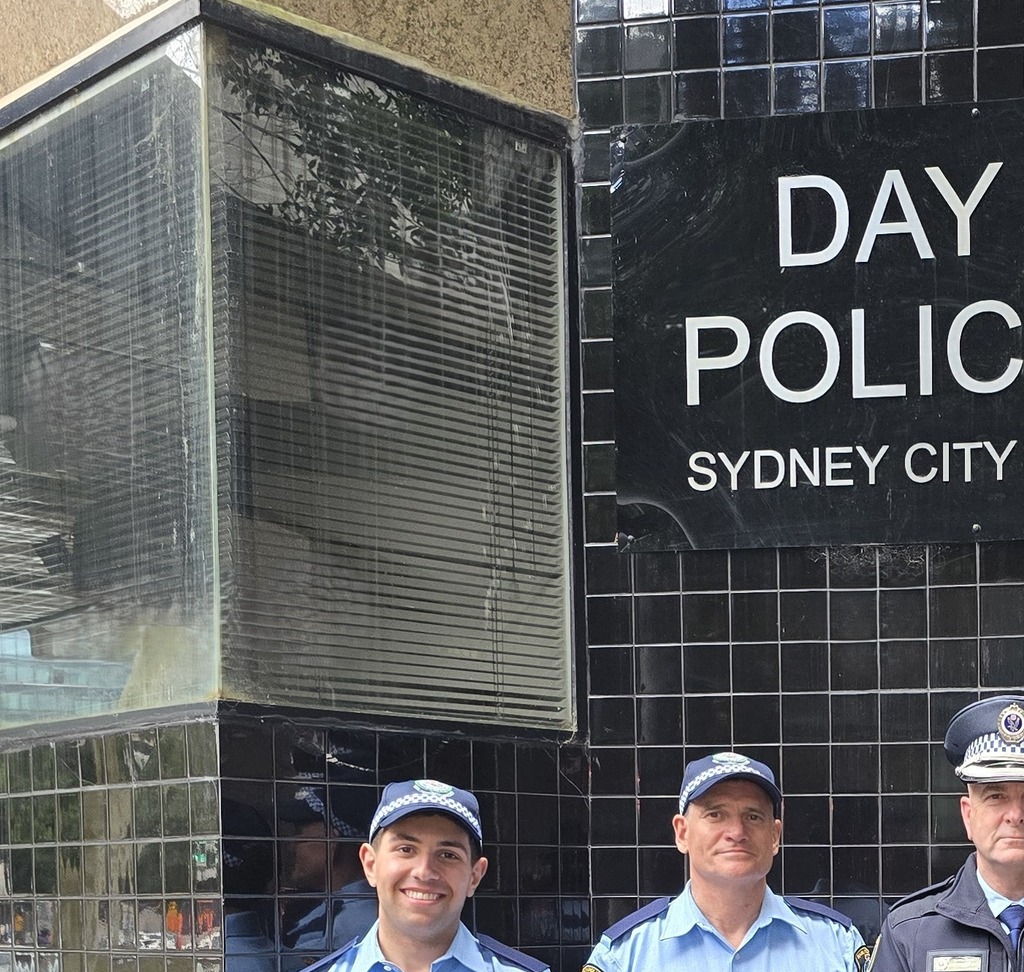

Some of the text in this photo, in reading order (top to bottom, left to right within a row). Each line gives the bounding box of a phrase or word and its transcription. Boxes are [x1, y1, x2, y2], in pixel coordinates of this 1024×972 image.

[777, 162, 1003, 268] DAY
[687, 445, 889, 492] SYDNEY
[904, 440, 1018, 484] CITY
